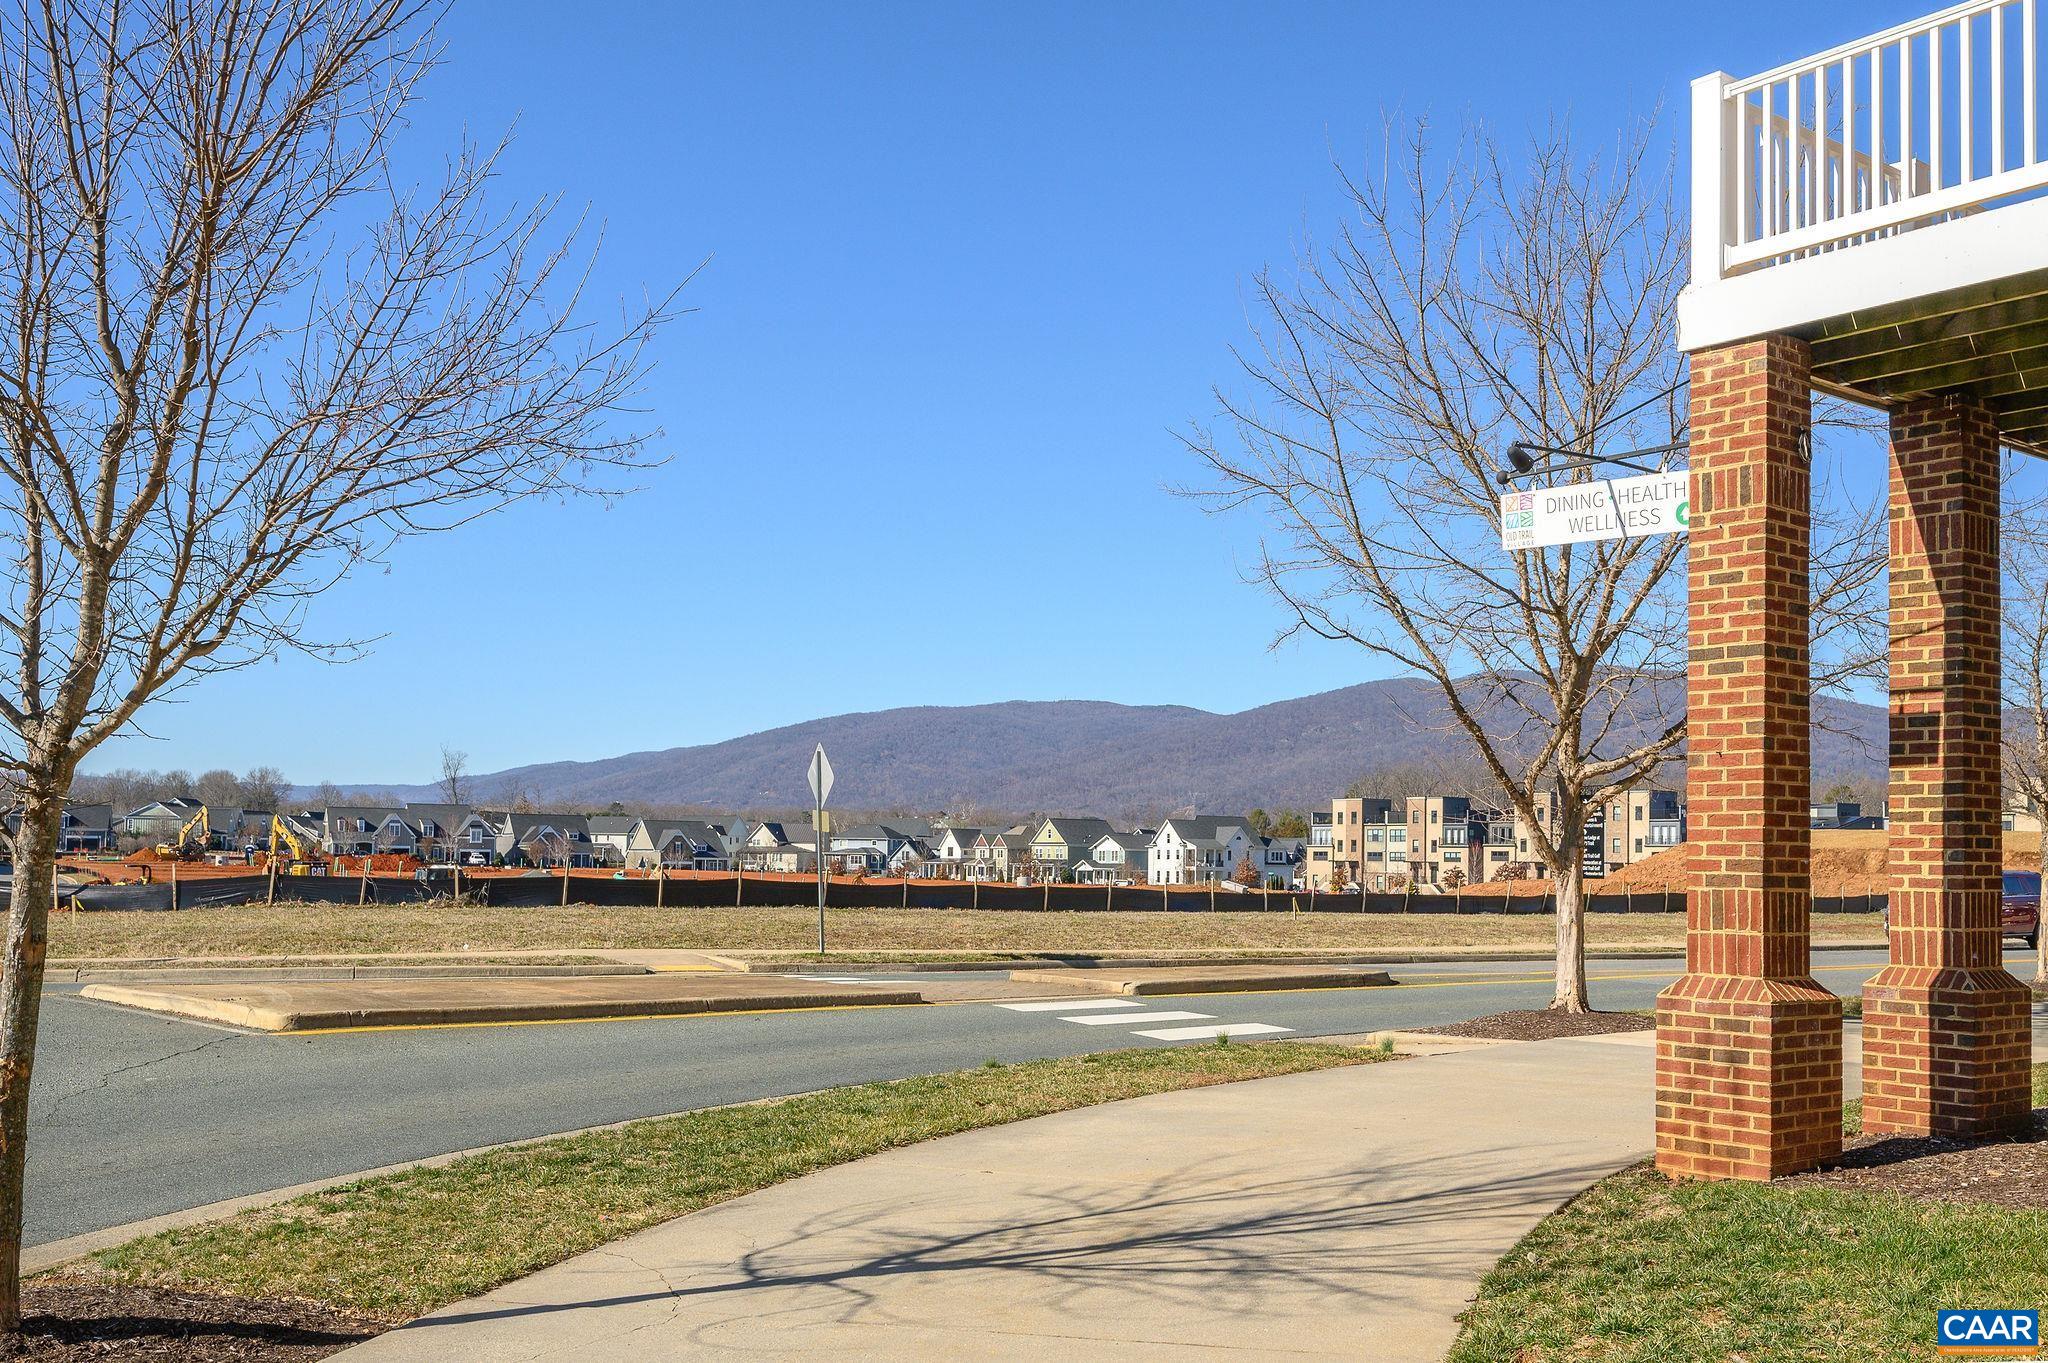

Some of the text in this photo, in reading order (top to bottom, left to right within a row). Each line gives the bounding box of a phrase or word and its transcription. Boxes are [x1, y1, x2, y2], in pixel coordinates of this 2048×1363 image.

[1546, 481, 1686, 514] DINING HEALTH
[1568, 508, 1661, 534] WELLNESS
[1518, 529, 1534, 541] TRAIL
[311, 867, 326, 877] CAT
